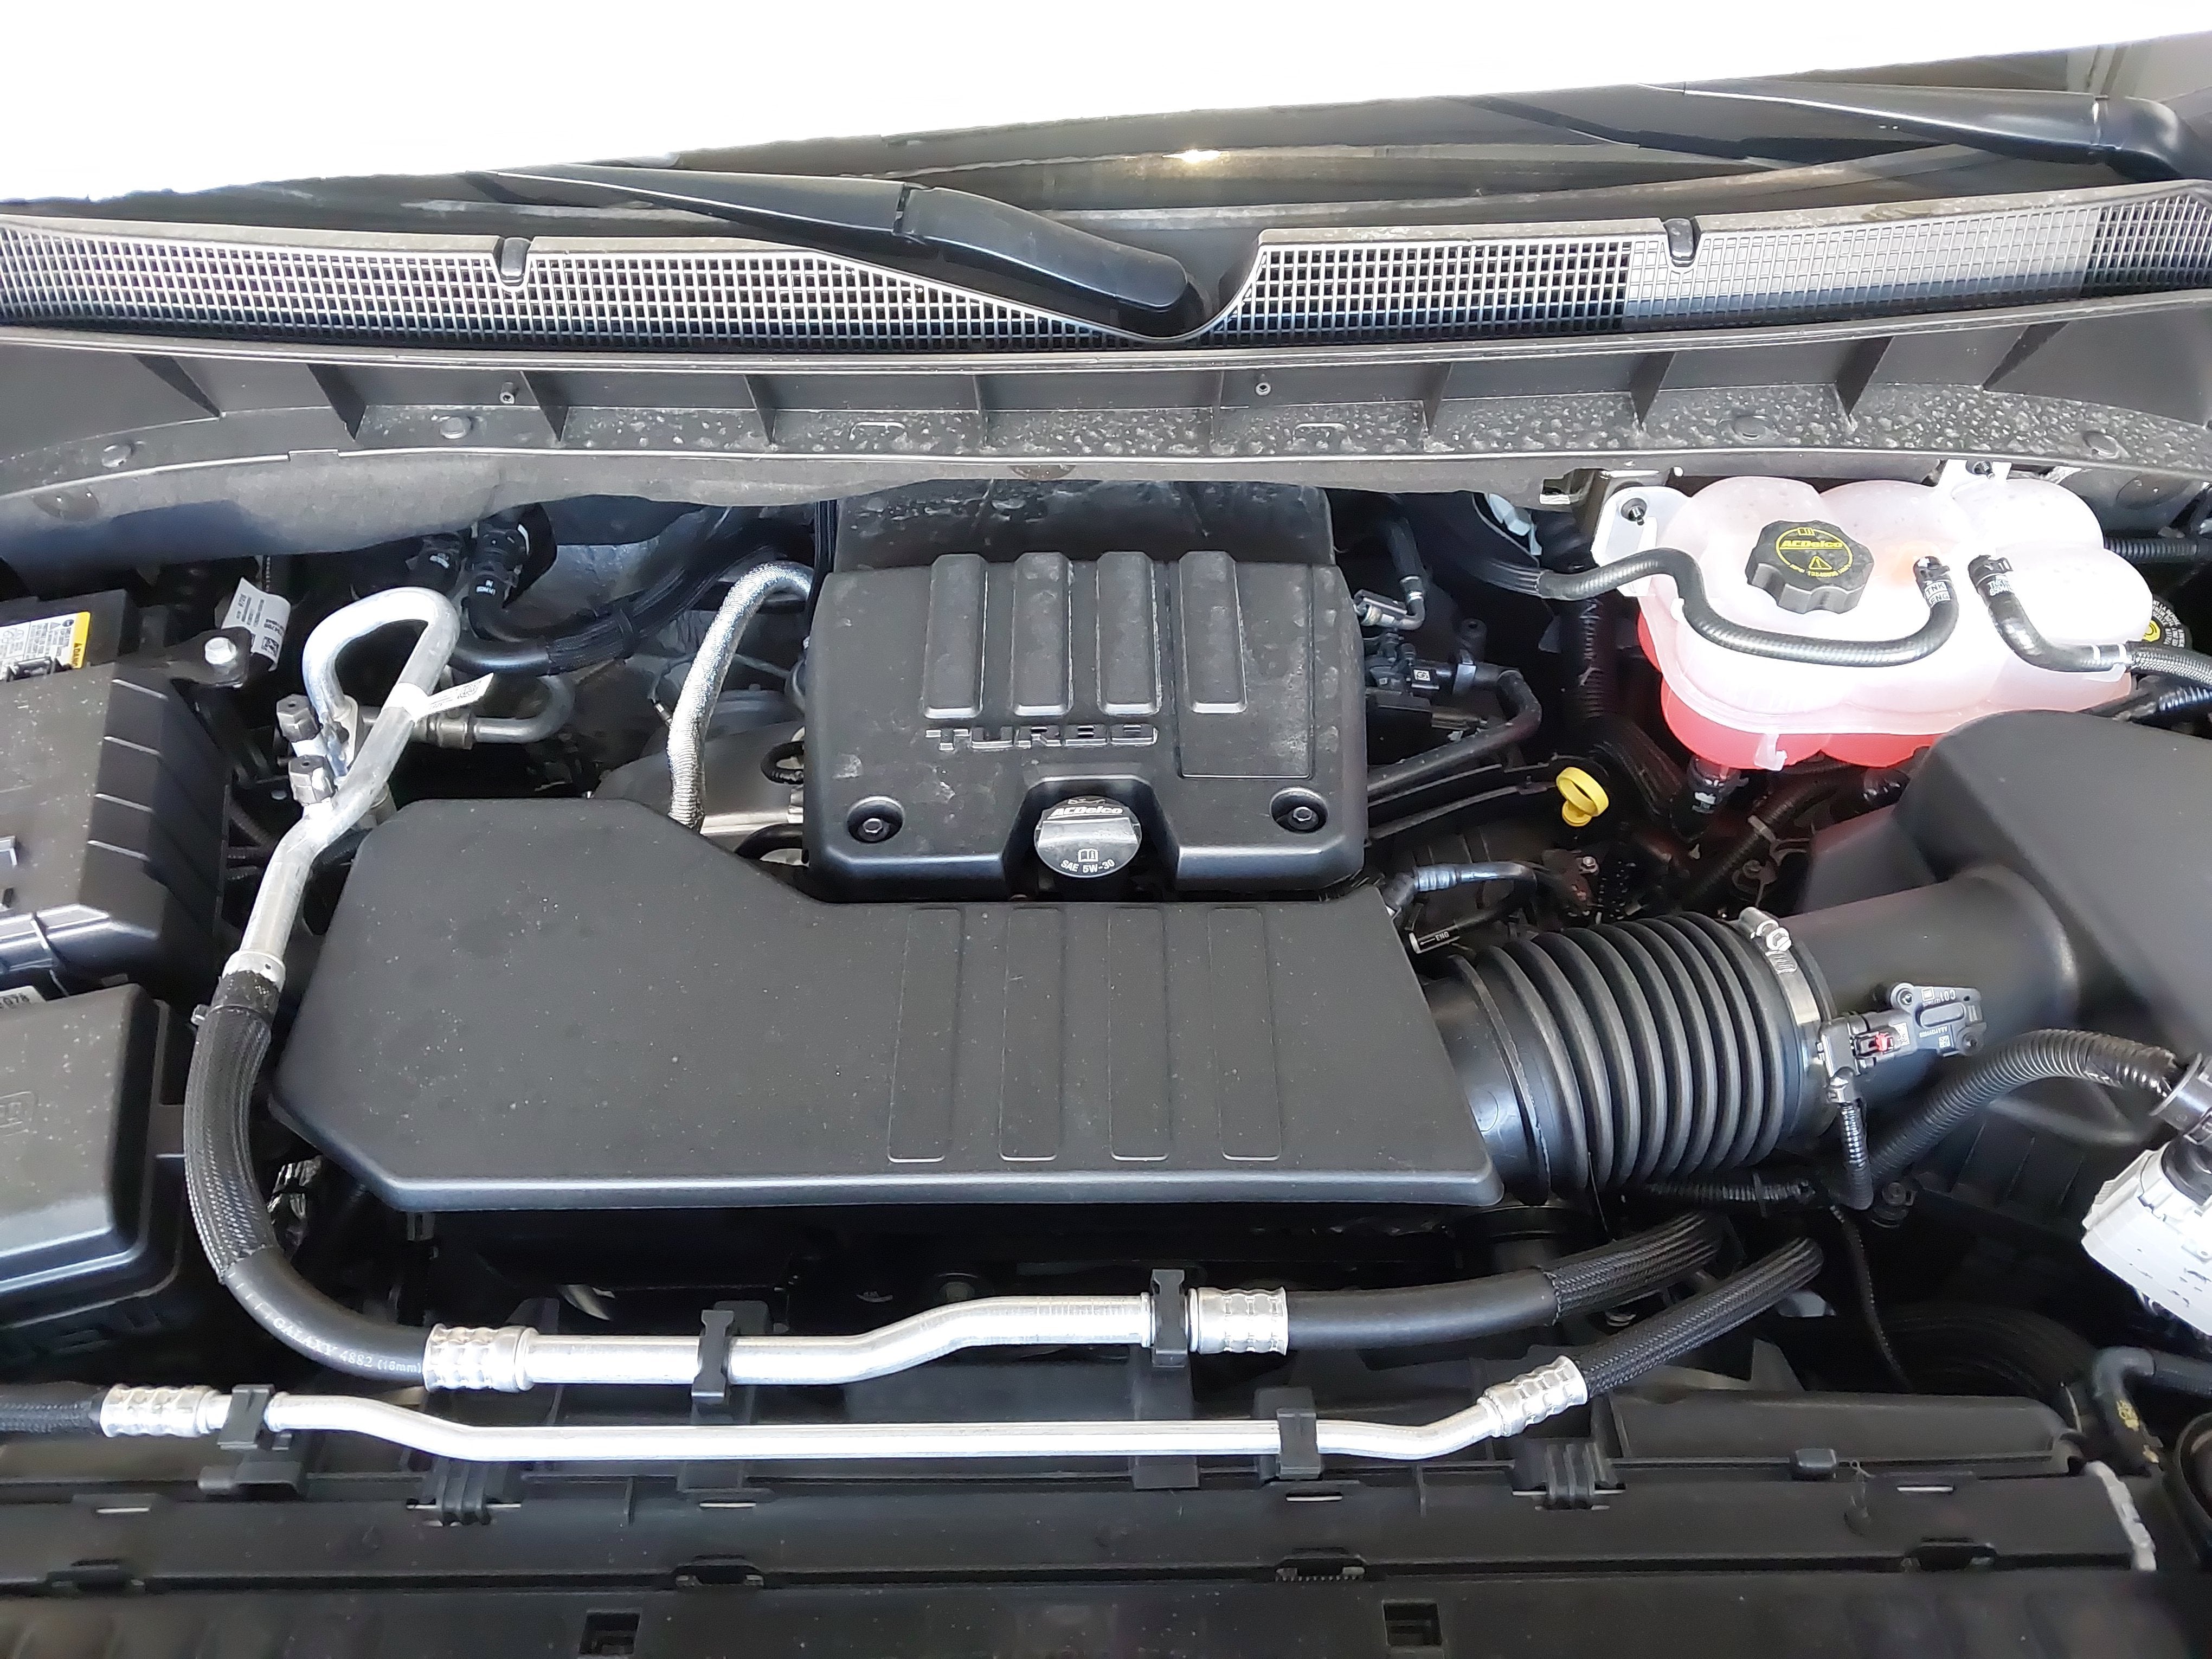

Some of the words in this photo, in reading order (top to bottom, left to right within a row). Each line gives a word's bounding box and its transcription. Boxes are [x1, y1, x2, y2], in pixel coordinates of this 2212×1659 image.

[1780, 540, 1843, 548] ACDelco
[1926, 583, 1945, 595] TNK
[1931, 593, 1949, 604] ENG
[925, 723, 1159, 751] TURBO
[1050, 806, 1123, 817] ACDelco
[1060, 859, 1079, 872] SAE
[1082, 859, 1115, 873] 5W-30
[273, 1317, 338, 1356] GALAXY
[339, 1349, 373, 1368] 4882
